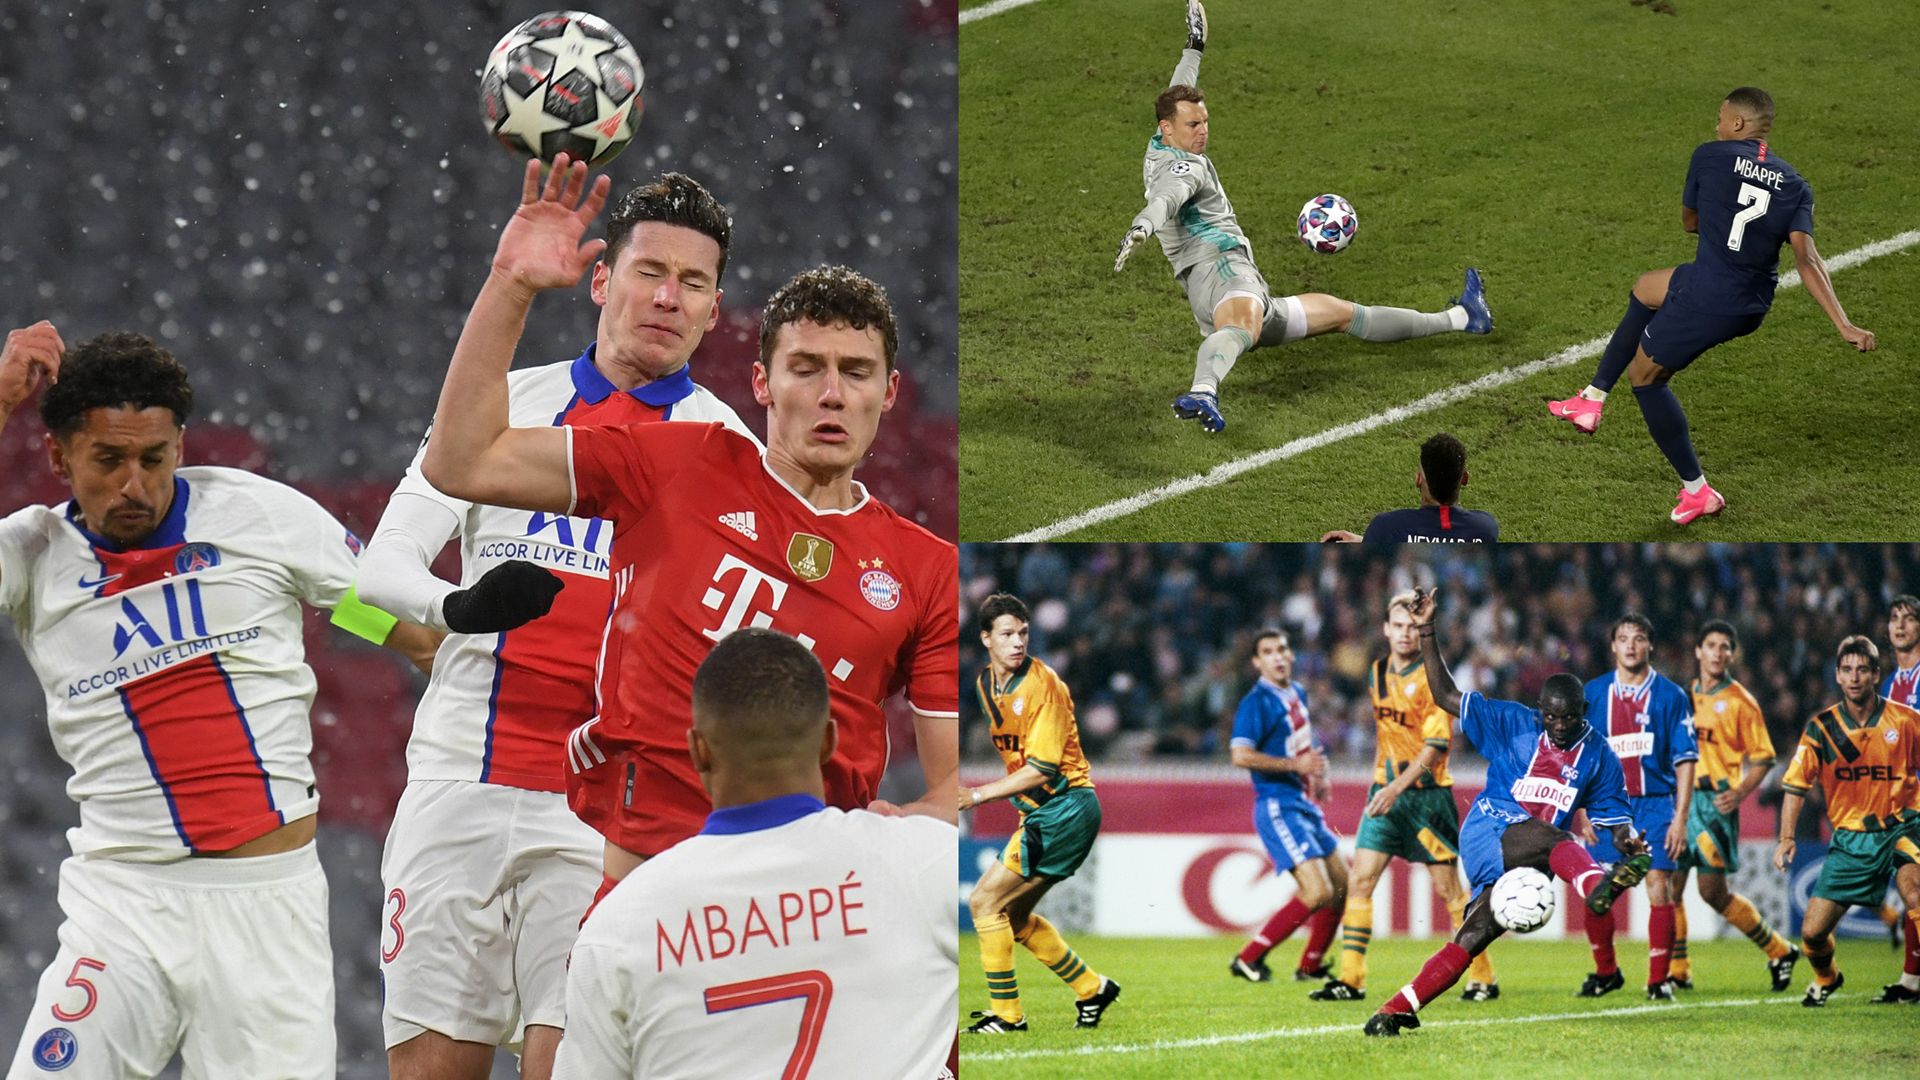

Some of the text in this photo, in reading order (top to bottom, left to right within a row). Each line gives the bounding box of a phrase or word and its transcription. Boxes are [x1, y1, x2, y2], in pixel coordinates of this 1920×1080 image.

[1733, 156, 1785, 191] MBAPPÉ
[1727, 182, 1771, 252] 7
[479, 542, 528, 559] ACCOR
[533, 545, 577, 567] LIVE
[68, 625, 262, 699] ACCOR LIVE LIMITLESS
[1561, 764, 1579, 780] PSG
[1834, 764, 1902, 782] OPEL
[382, 888, 407, 964] 3
[656, 870, 868, 973] MBAPPÉ
[51, 957, 106, 1022] 5
[703, 969, 834, 1080] 7
